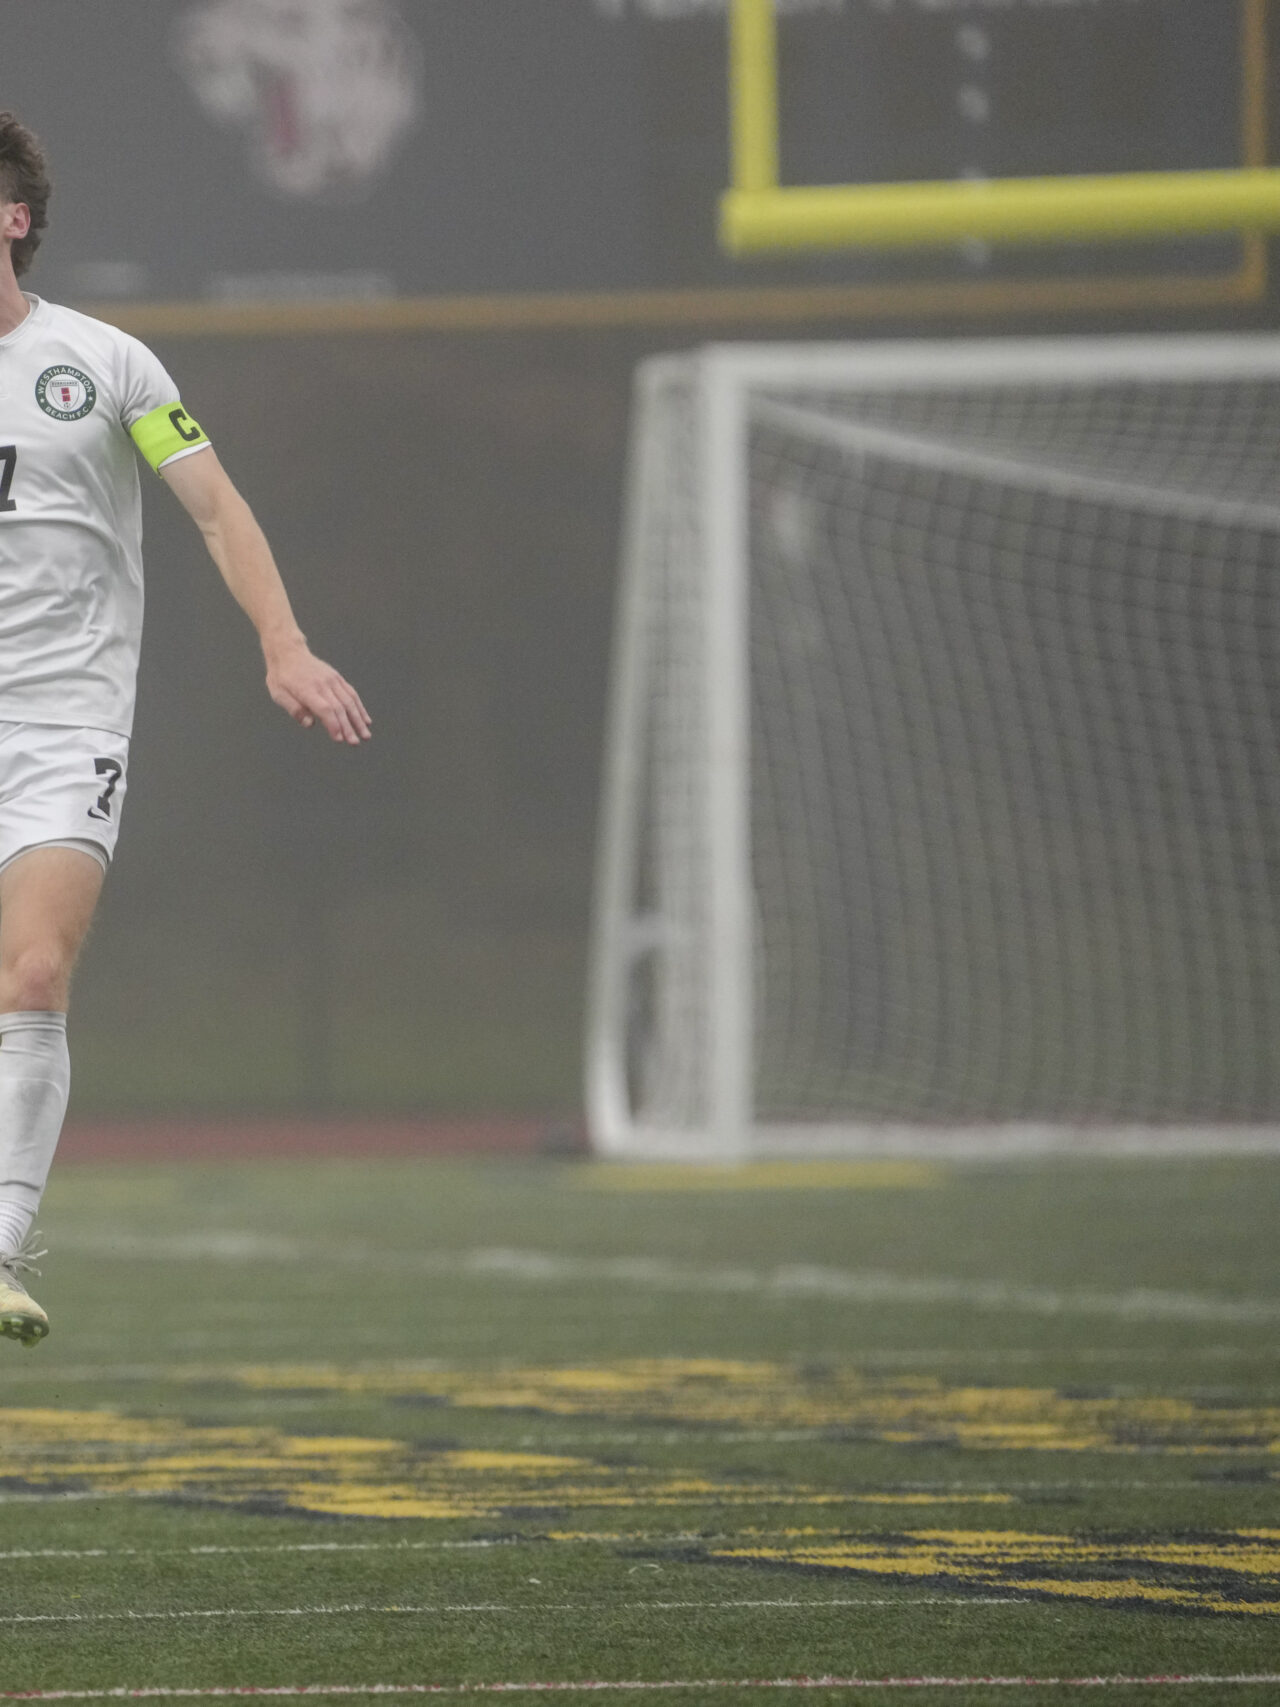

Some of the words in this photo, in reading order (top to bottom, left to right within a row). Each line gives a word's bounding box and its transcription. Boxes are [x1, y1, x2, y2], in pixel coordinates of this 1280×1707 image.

[37, 366, 94, 394] WESTHAMPTON
[45, 406, 75, 420] BEACH
[168, 408, 201, 441] C
[94, 757, 122, 818] 7
